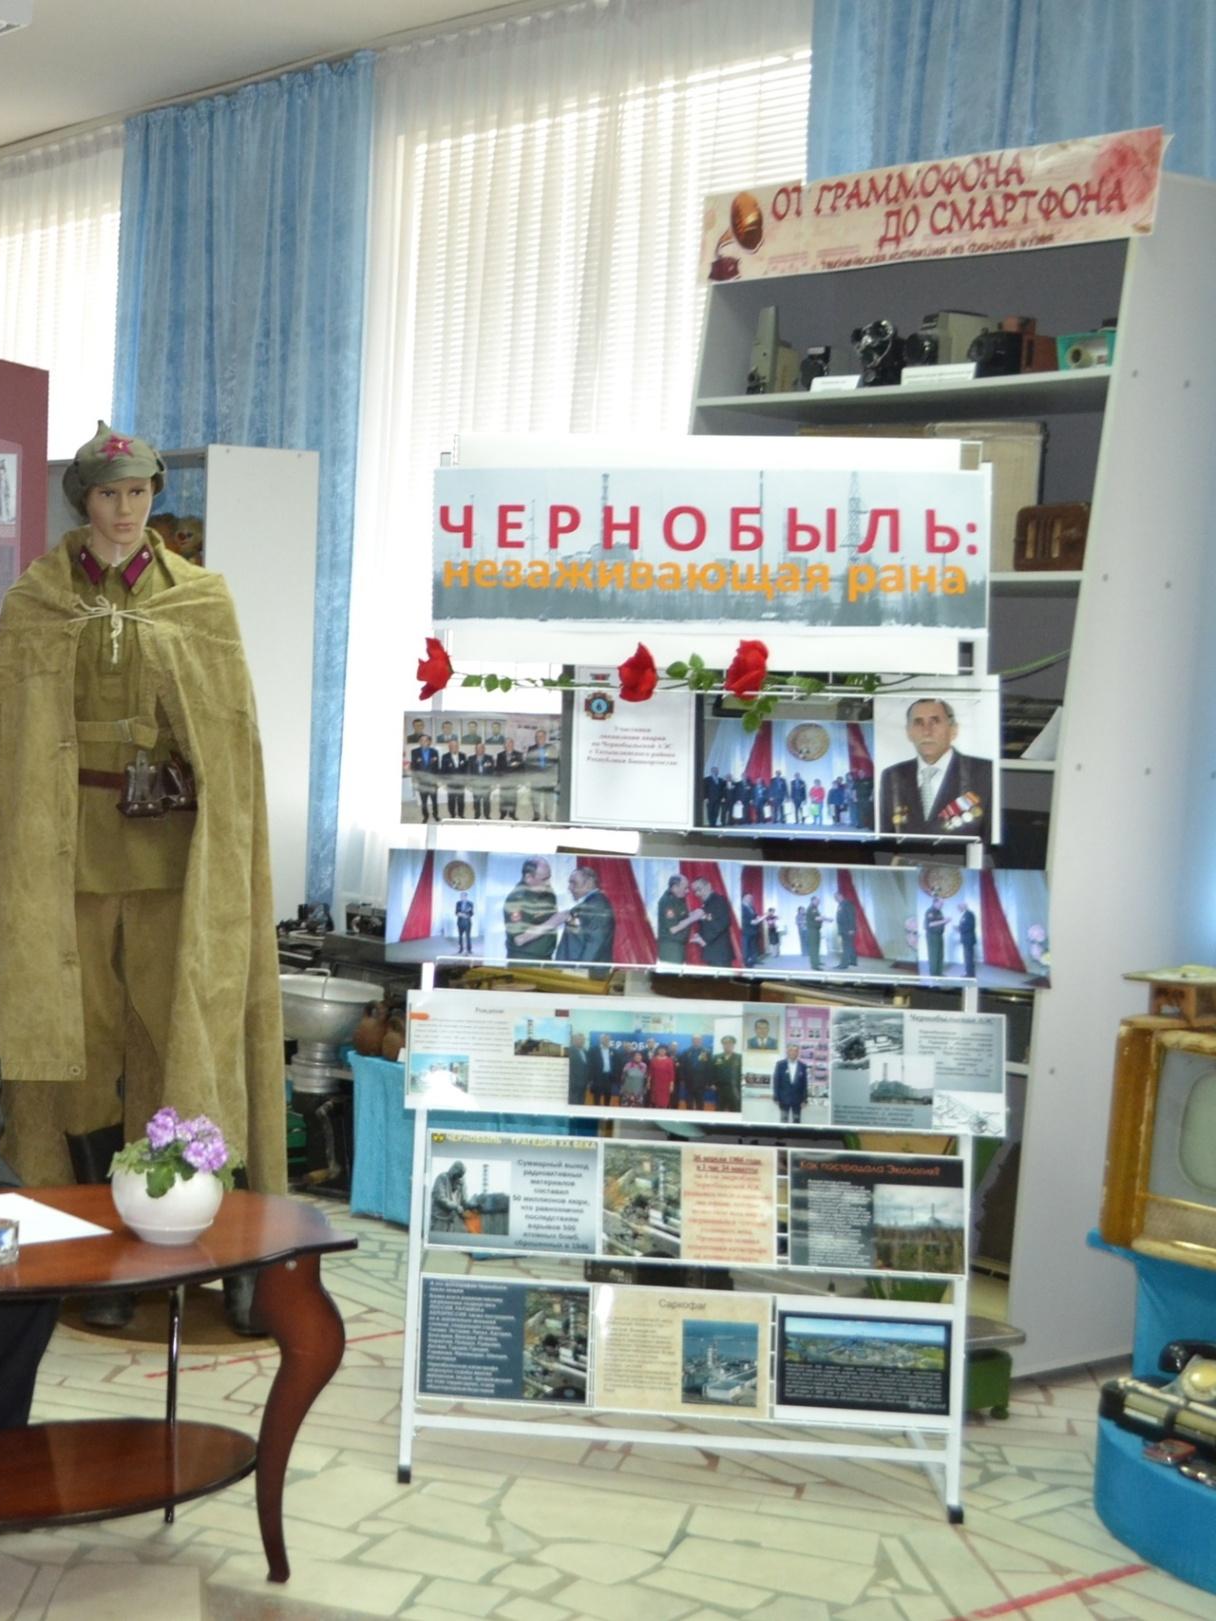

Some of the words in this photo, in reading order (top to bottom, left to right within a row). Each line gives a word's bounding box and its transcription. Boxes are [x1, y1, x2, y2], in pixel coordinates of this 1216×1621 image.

[771, 187, 803, 222] ОТ
[813, 153, 1026, 216] ГРАММОФОНА
[877, 208, 920, 250] ДО
[929, 179, 1127, 237] СМАРТФОНА
[439, 504, 978, 555] ЧЕРНОБЫЛЬ:
[443, 558, 830, 599] незаживающая
[847, 561, 967, 602] рана
[658, 1298, 706, 1311] Саркофаг
